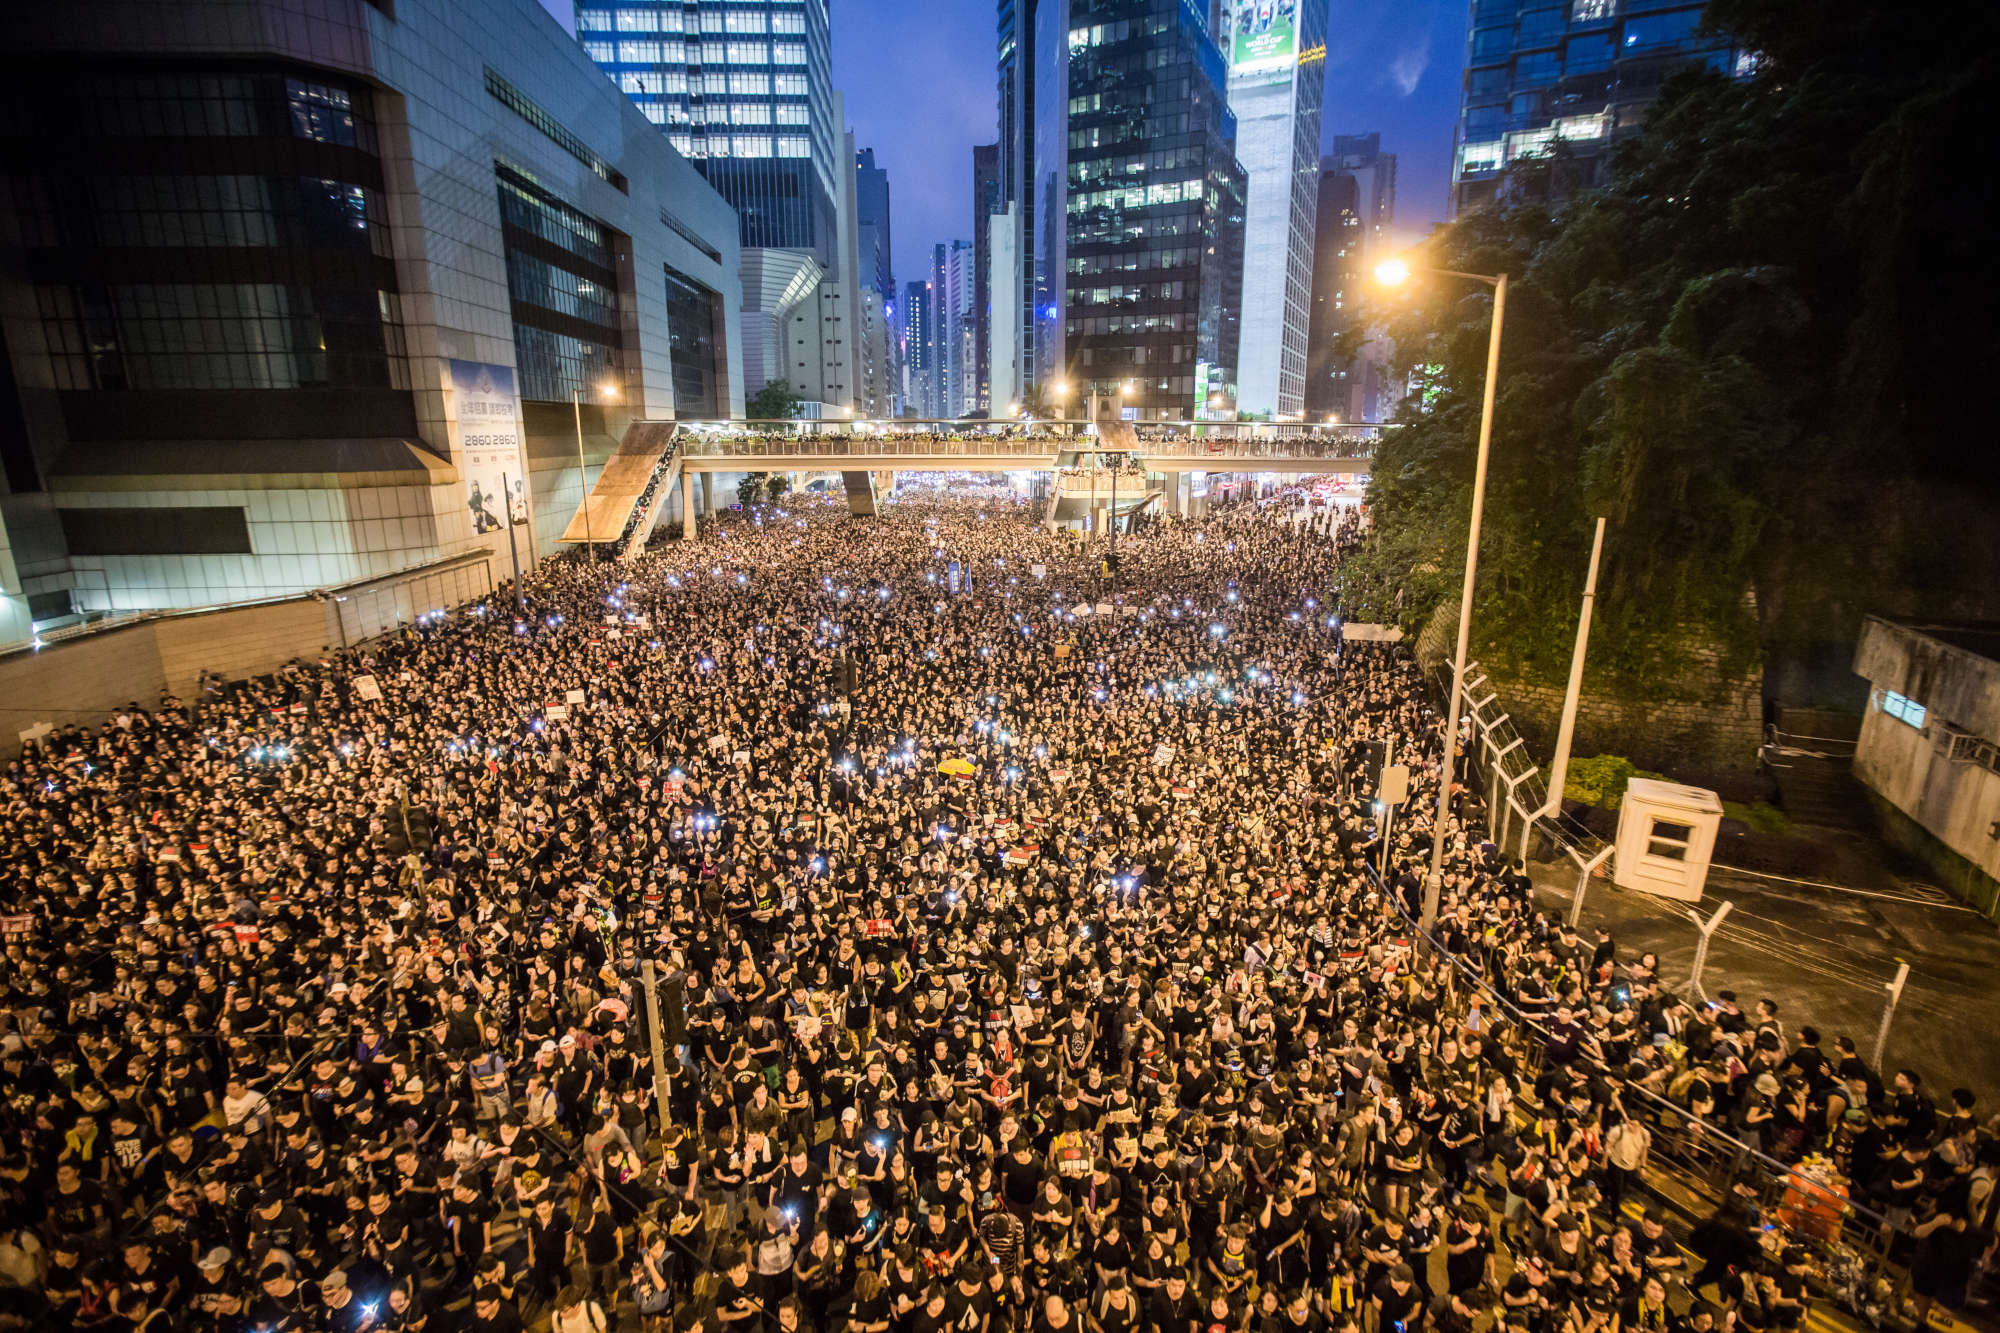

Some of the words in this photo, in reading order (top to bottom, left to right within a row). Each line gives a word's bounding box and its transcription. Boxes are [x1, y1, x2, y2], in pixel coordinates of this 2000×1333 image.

[1245, 38, 1269, 48] WORLD
[464, 434, 491, 446] 2860
[493, 434, 517, 445] 2860
